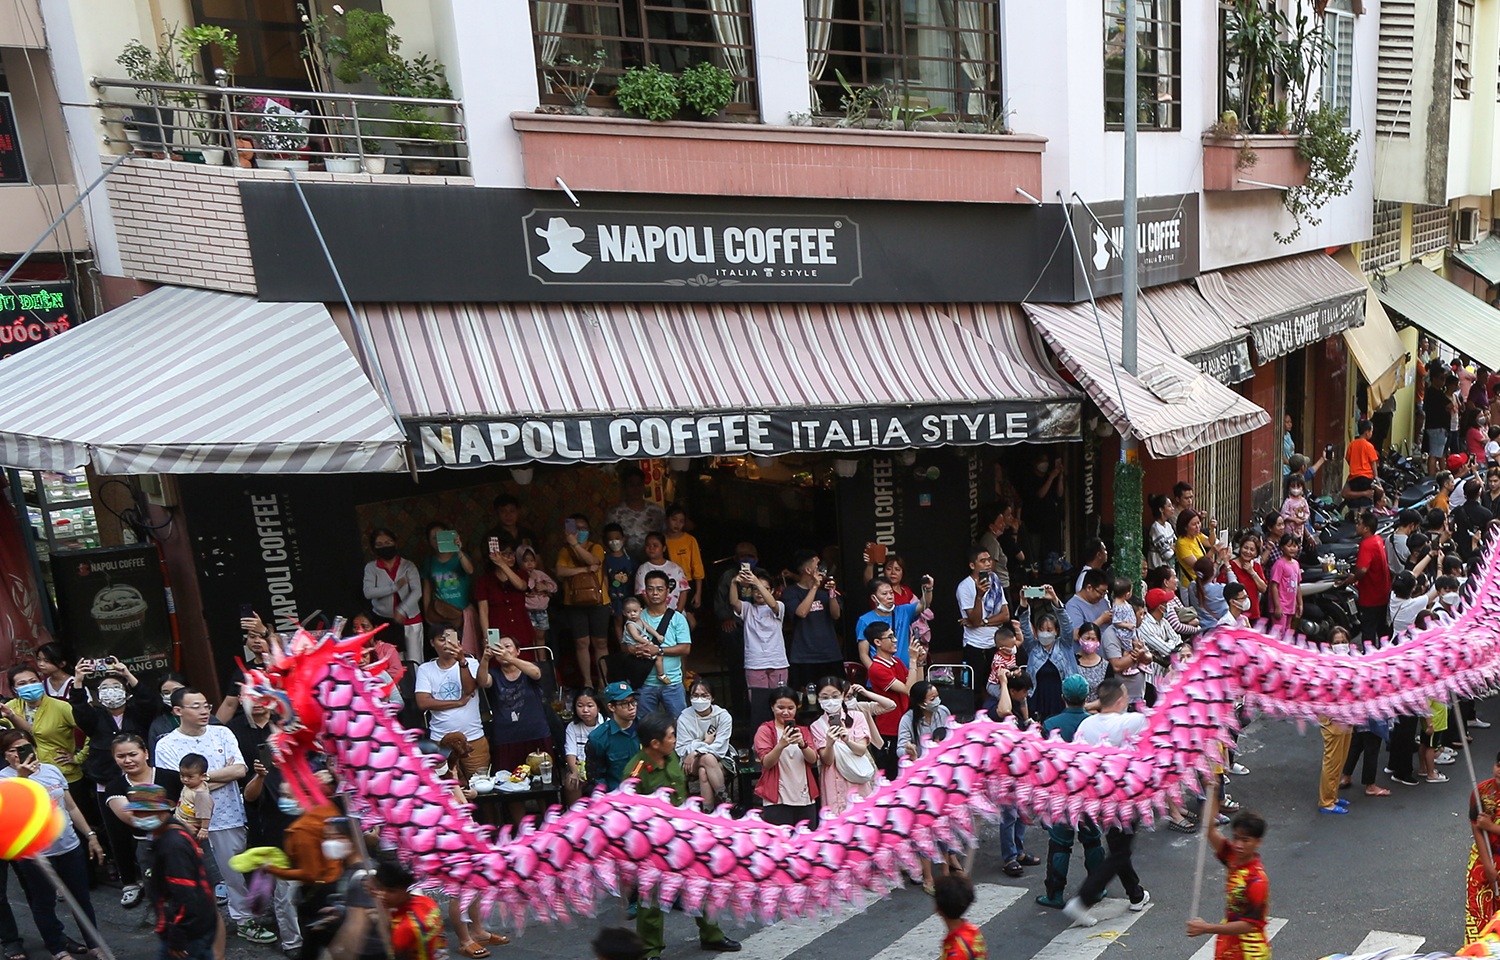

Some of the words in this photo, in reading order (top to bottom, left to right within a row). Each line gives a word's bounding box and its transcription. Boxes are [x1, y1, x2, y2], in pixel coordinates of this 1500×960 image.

[597, 224, 716, 263] NAPOLI
[723, 226, 837, 265] COFFEE
[1148, 219, 1180, 252] COFFEE
[716, 269, 758, 277] ITALIA
[780, 269, 818, 278] STYLE
[0, 316, 42, 344] UỐC
[419, 421, 597, 466] NAPOLI
[608, 414, 775, 457] COFFEE
[791, 417, 912, 449] ITALIA
[921, 412, 1029, 441] STYLE
[873, 457, 894, 517] COFFEE
[251, 494, 287, 562] COFFEE
[90, 561, 118, 573] NAPOLI
[118, 557, 146, 569] COFFEE
[265, 566, 300, 632] NAPOLI
[100, 621, 121, 632] NAPOLI
[121, 619, 142, 630] COFFEE
[128, 660, 153, 672] ANG
